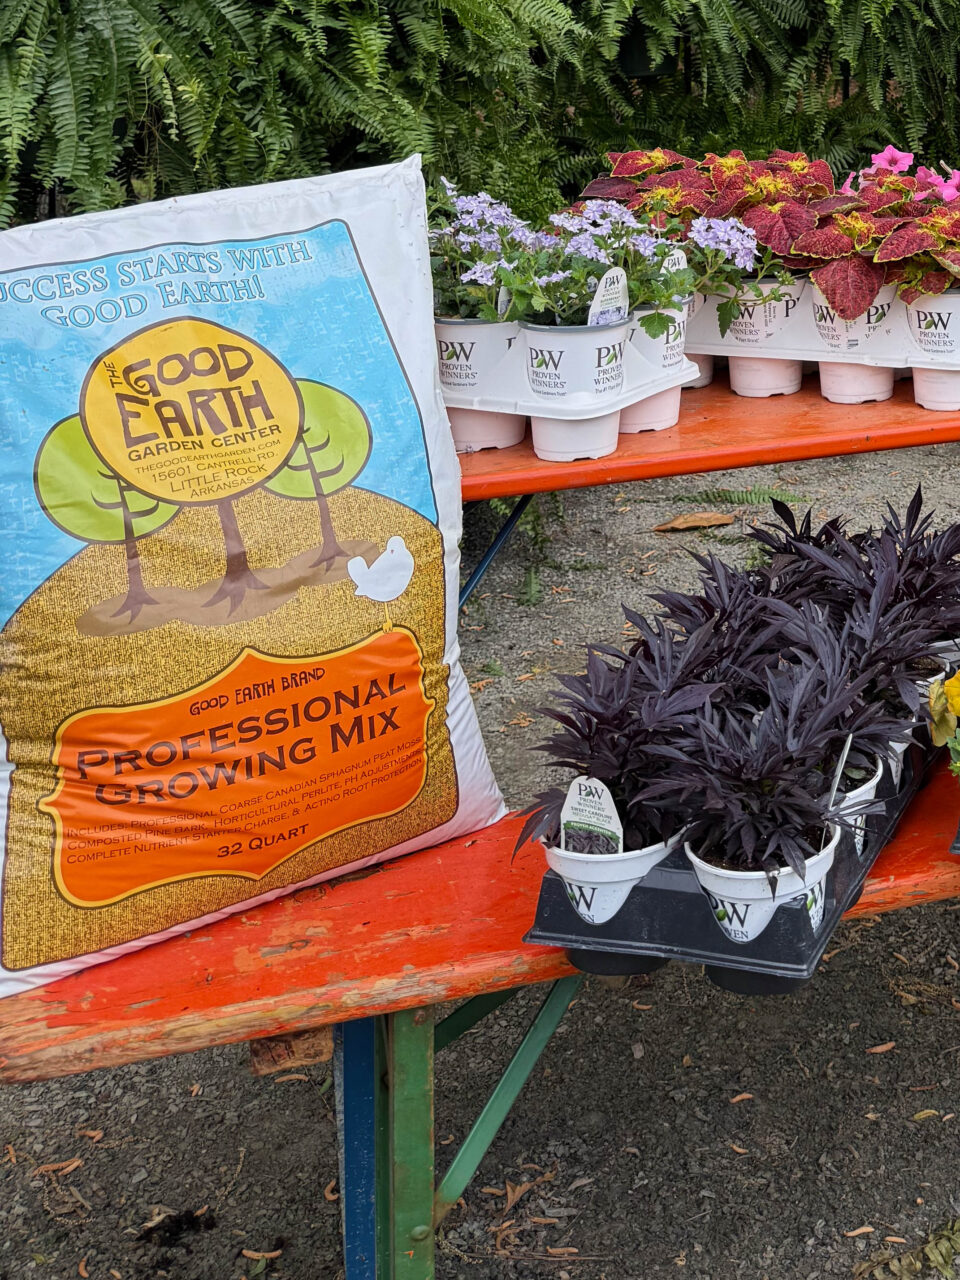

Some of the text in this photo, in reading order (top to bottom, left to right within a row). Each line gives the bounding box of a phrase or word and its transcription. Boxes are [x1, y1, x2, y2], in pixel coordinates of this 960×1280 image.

[0, 240, 312, 303] CCESS STARTS WITH
[41, 275, 265, 328] GOOD EARTH!
[739, 302, 757, 320] W
[916, 310, 953, 331] PW
[920, 330, 950, 339] PROVEN
[438, 340, 477, 362] PW
[529, 346, 565, 371] PW
[595, 341, 625, 368] PW
[103, 361, 123, 388] THE
[122, 344, 254, 397] GOOD
[441, 362, 472, 371] PROVEN
[532, 369, 560, 380] PROVEN
[115, 380, 275, 449] EARTH
[128, 424, 282, 463] GARDEN CENTER
[135, 439, 281, 474] THEGOODEARTHGARDEN.COM
[152, 451, 279, 483] 15601 CANTRELL RD.
[170, 464, 267, 493] LITTLE ROCK
[190, 476, 254, 499] ARKANSAS
[189, 667, 326, 716] GOOD EARTH BRAND
[77, 672, 407, 780] PROFESSIONAL
[95, 705, 401, 806] GROWING MIX
[66, 823, 129, 838] INCLUDES:
[130, 810, 218, 829] PROFESSIONAL
[219, 795, 264, 814] COARSE
[265, 778, 318, 801] CANADIAN
[319, 758, 371, 782] SPHAGNUM
[373, 749, 395, 763] PEAT
[577, 783, 605, 800] PW
[579, 797, 603, 806] PROVEN
[66, 756, 422, 864] COMPLETE NUTRIENT STARTER CHARGE, & ACTINO ROOT PROTECTION
[67, 832, 142, 851] COMPOSTED
[145, 827, 173, 838] PINE
[214, 796, 299, 828] HORTICULTURAL
[301, 781, 342, 802] PERLITE,
[577, 801, 606, 812] WINNERS
[217, 823, 309, 858] 32 QUART
[567, 882, 598, 912] W
[725, 928, 749, 939] VEN
